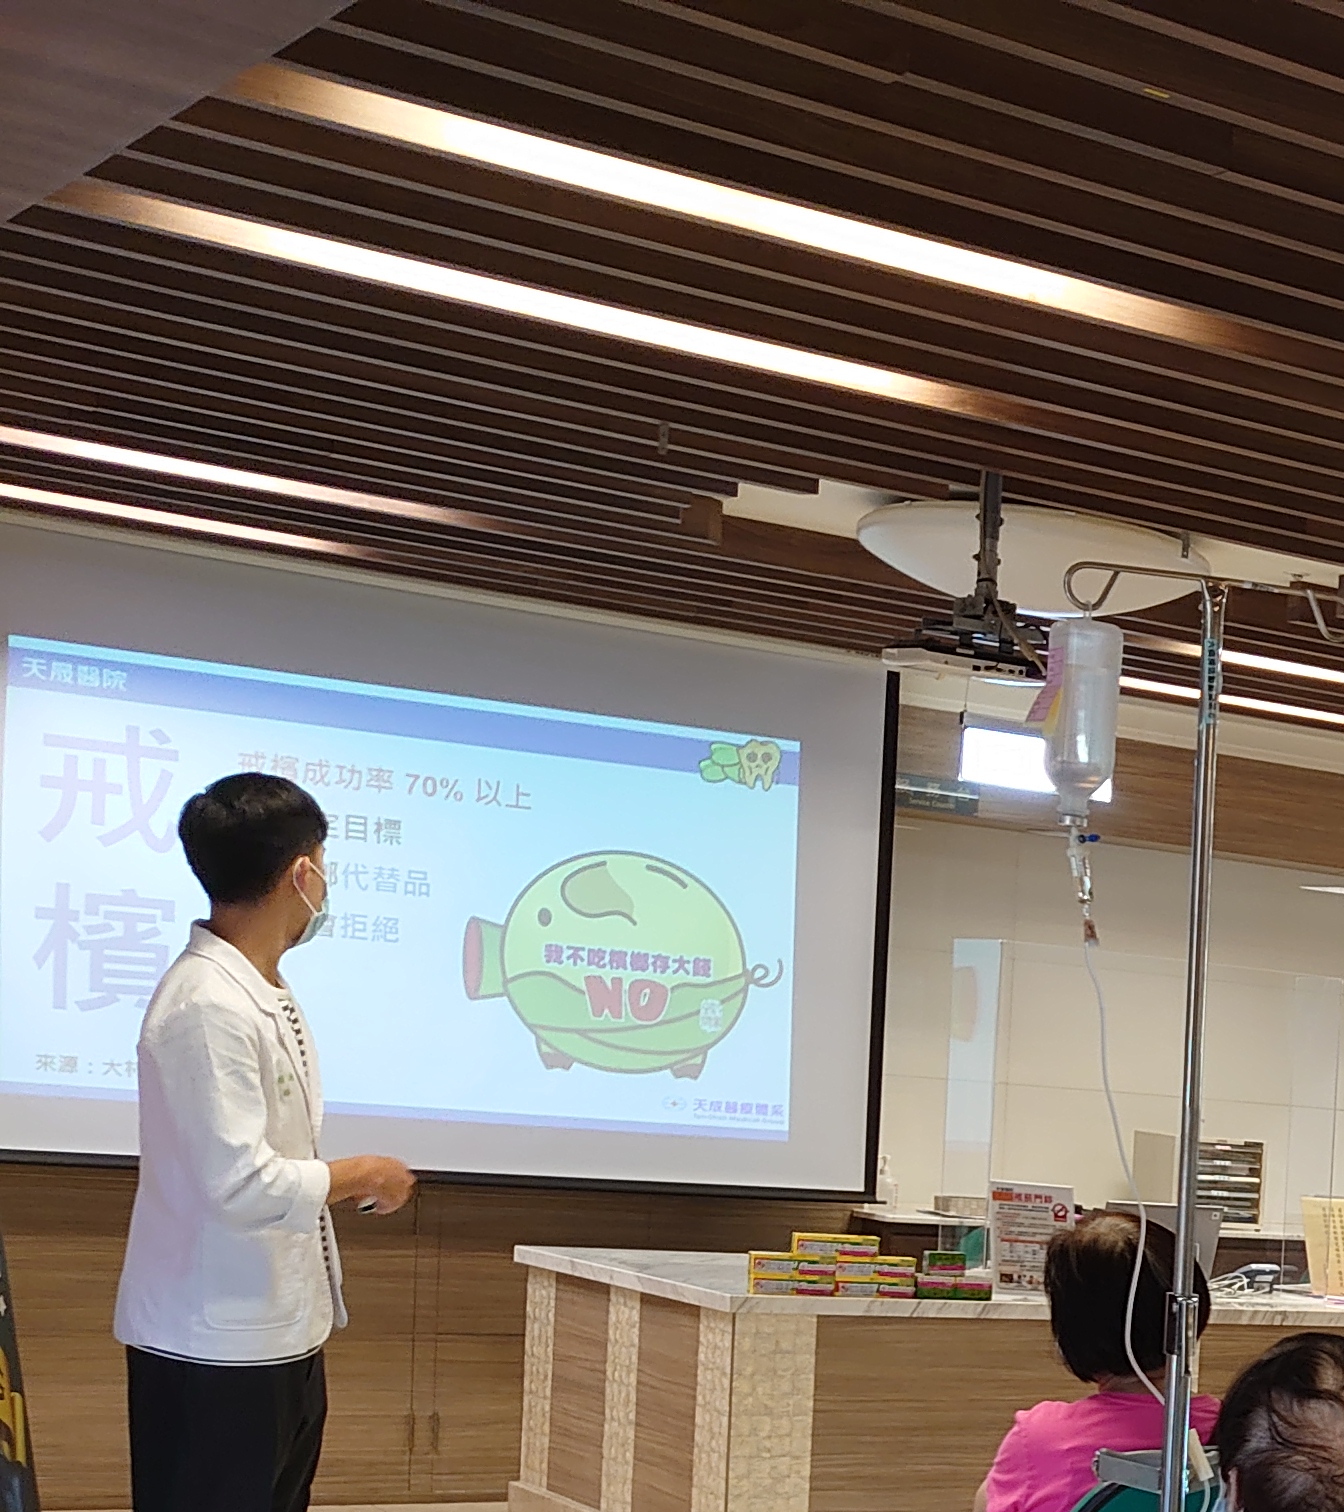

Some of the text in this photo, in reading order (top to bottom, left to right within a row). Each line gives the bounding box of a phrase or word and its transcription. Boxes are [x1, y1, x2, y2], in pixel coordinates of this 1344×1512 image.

[405, 772, 464, 803] 70%
[474, 777, 533, 812] 以上
[543, 942, 713, 980] 我不吃檳榔存大錢
[583, 974, 670, 1023] NO
